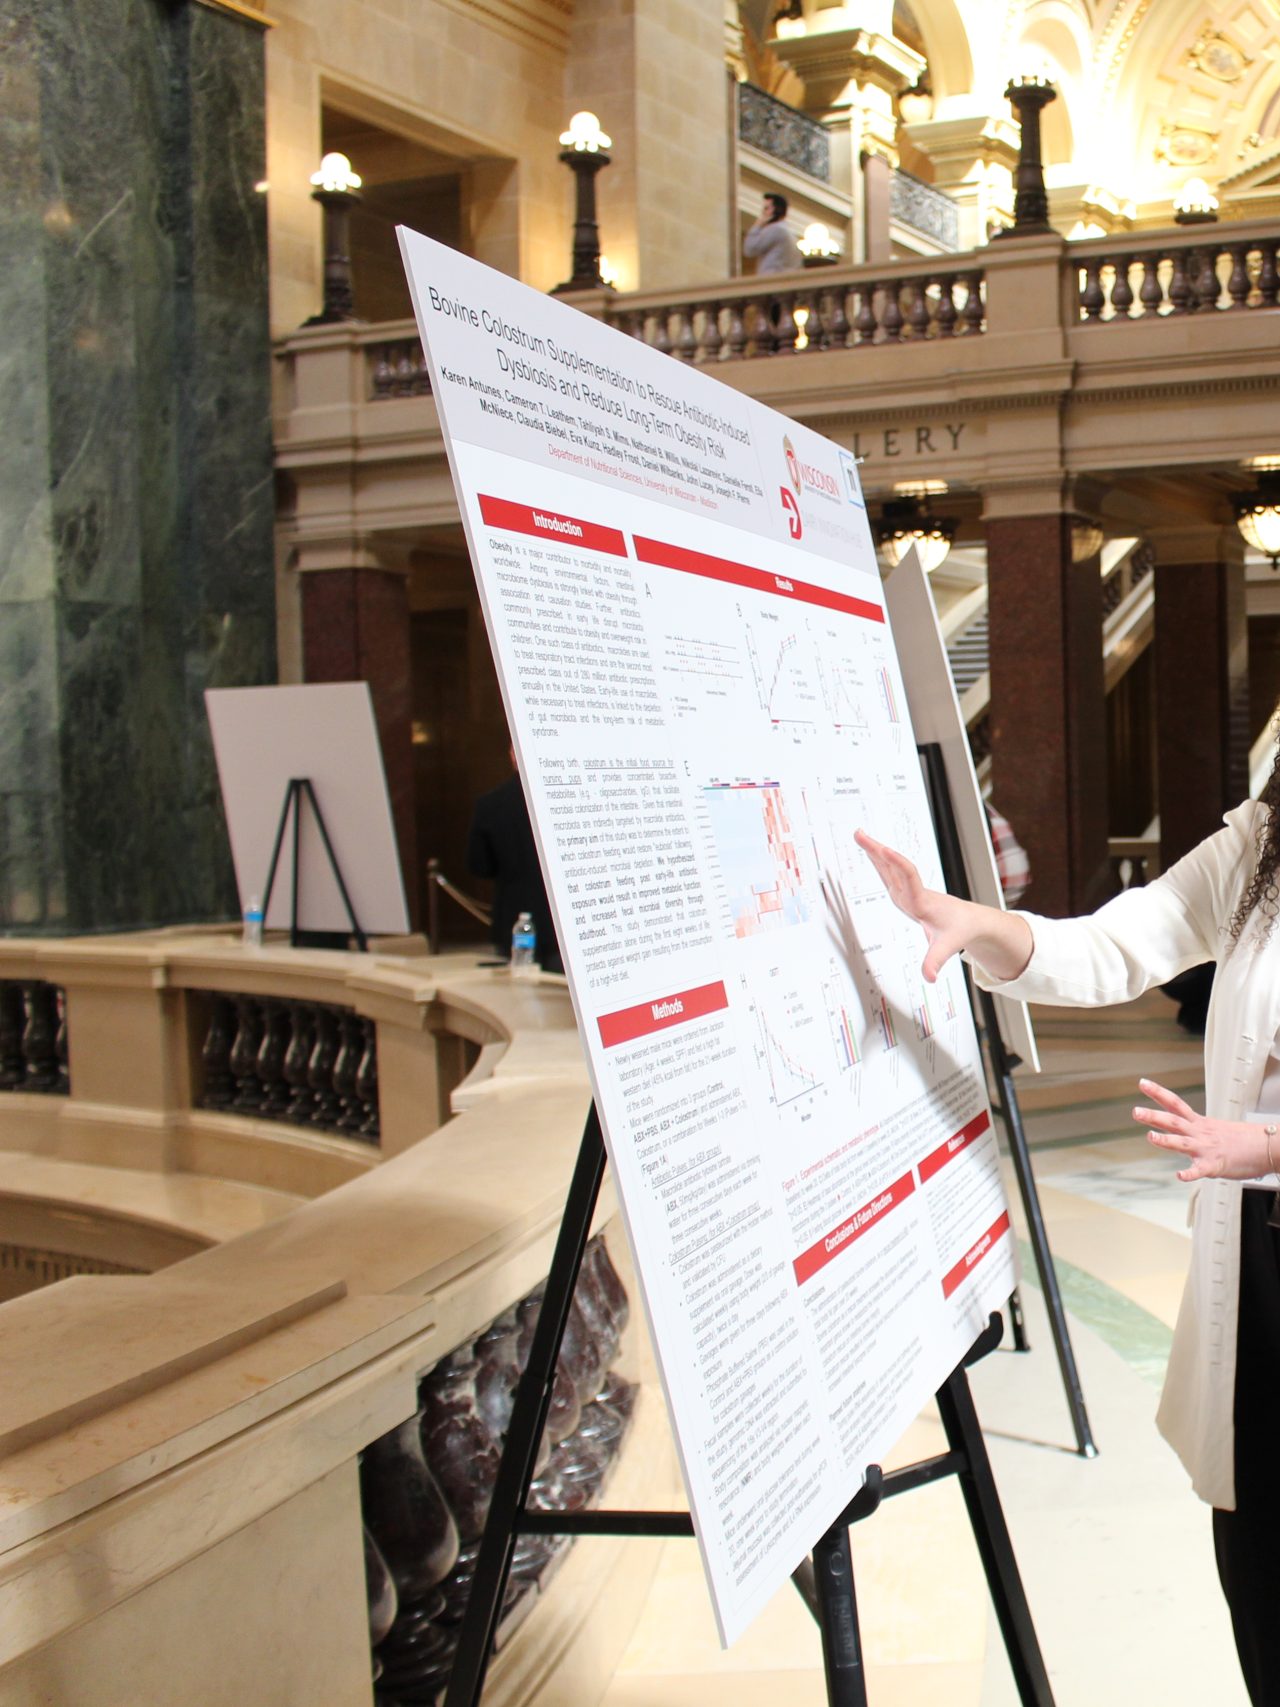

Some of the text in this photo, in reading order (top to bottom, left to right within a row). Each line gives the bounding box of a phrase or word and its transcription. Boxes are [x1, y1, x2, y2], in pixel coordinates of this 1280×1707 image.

[428, 287, 751, 447] Bovine Colostrum Supplementation to Rescue Antibiotic-Induced
[440, 365, 468, 387] Karen
[468, 376, 505, 403] Antunes,
[504, 390, 539, 414] Cameron
[538, 403, 547, 416] T.
[546, 406, 579, 430] Leathem,
[604, 428, 613, 441] S.
[496, 349, 726, 460] Dysbiosis and Reduce Long-Term Obesity Risk
[799, 462, 840, 497] WISCONSIN
[532, 511, 584, 539] Introduction
[488, 537, 514, 556] Obesity
[774, 576, 794, 593] Results
[651, 998, 684, 1022] Methods
[824, 1221, 855, 1255] Conclusions
[857, 1207, 873, 1229] Future
[871, 1191, 893, 1217] Directions
